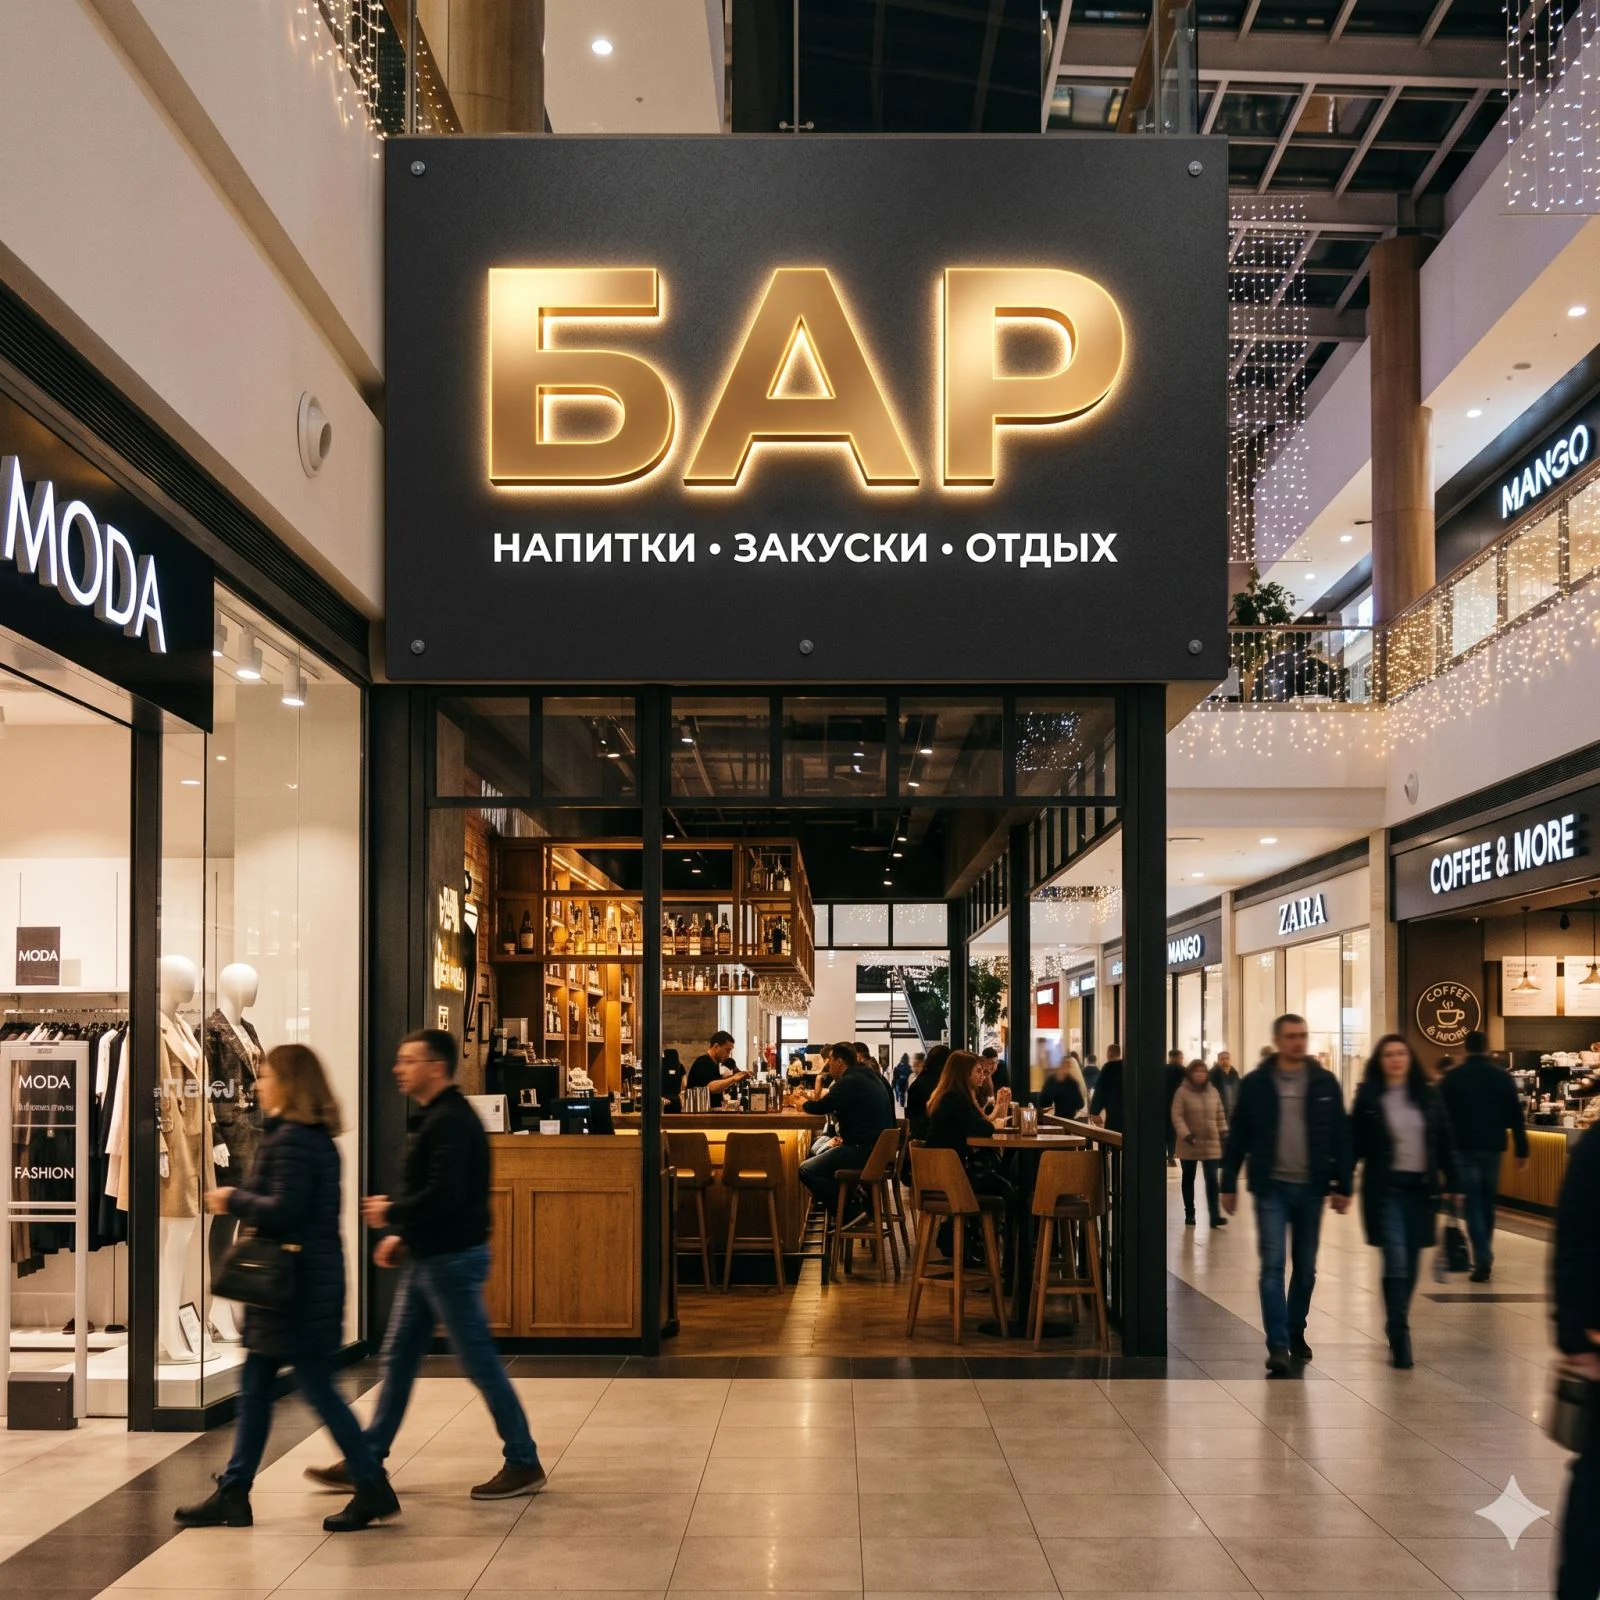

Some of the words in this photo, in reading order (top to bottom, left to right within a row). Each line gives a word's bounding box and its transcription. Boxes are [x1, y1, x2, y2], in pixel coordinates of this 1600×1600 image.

[488, 267, 1126, 487] БАР
[1502, 424, 1589, 519] MANGO
[2, 455, 167, 654] MODA
[493, 532, 696, 563] НАПИТКИ
[733, 531, 928, 564] ЗАКУСКИ
[965, 531, 1119, 569] ОТДЫХ
[1430, 841, 1492, 895] COFFEE
[1495, 835, 1509, 878] &
[1513, 813, 1575, 872] MORE
[1278, 892, 1326, 935] ZARA
[18, 949, 59, 962] MODA
[1167, 933, 1202, 965] MANGO
[1426, 986, 1471, 1002] COFFEE
[18, 1074, 71, 1089] MODA
[14, 1166, 75, 1179] FASHION
